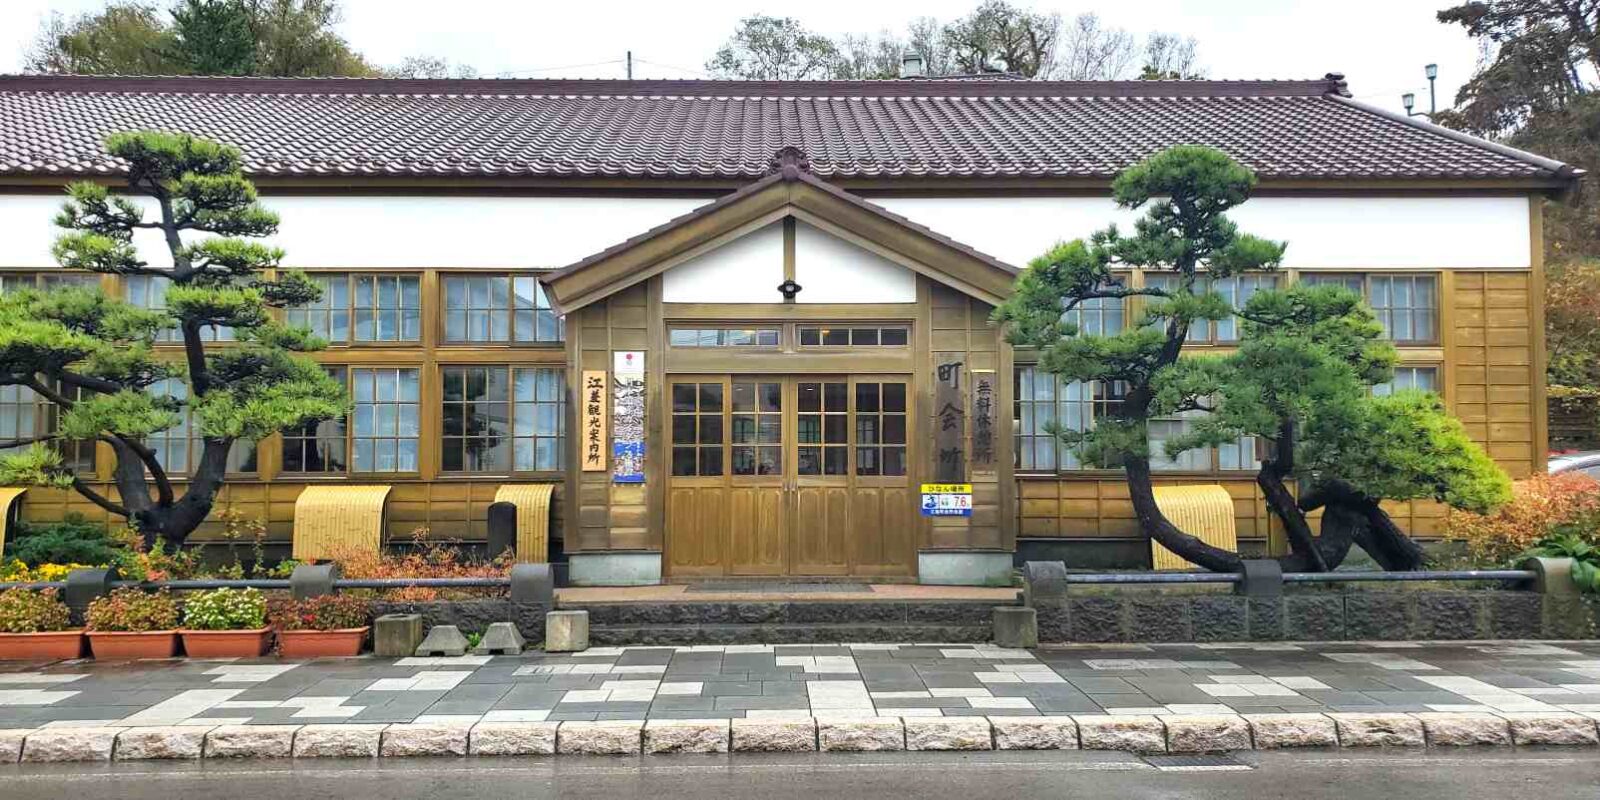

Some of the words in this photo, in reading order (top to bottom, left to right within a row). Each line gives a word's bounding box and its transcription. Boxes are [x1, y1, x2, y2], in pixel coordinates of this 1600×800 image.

[587, 376, 603, 466] 江差観光案内所
